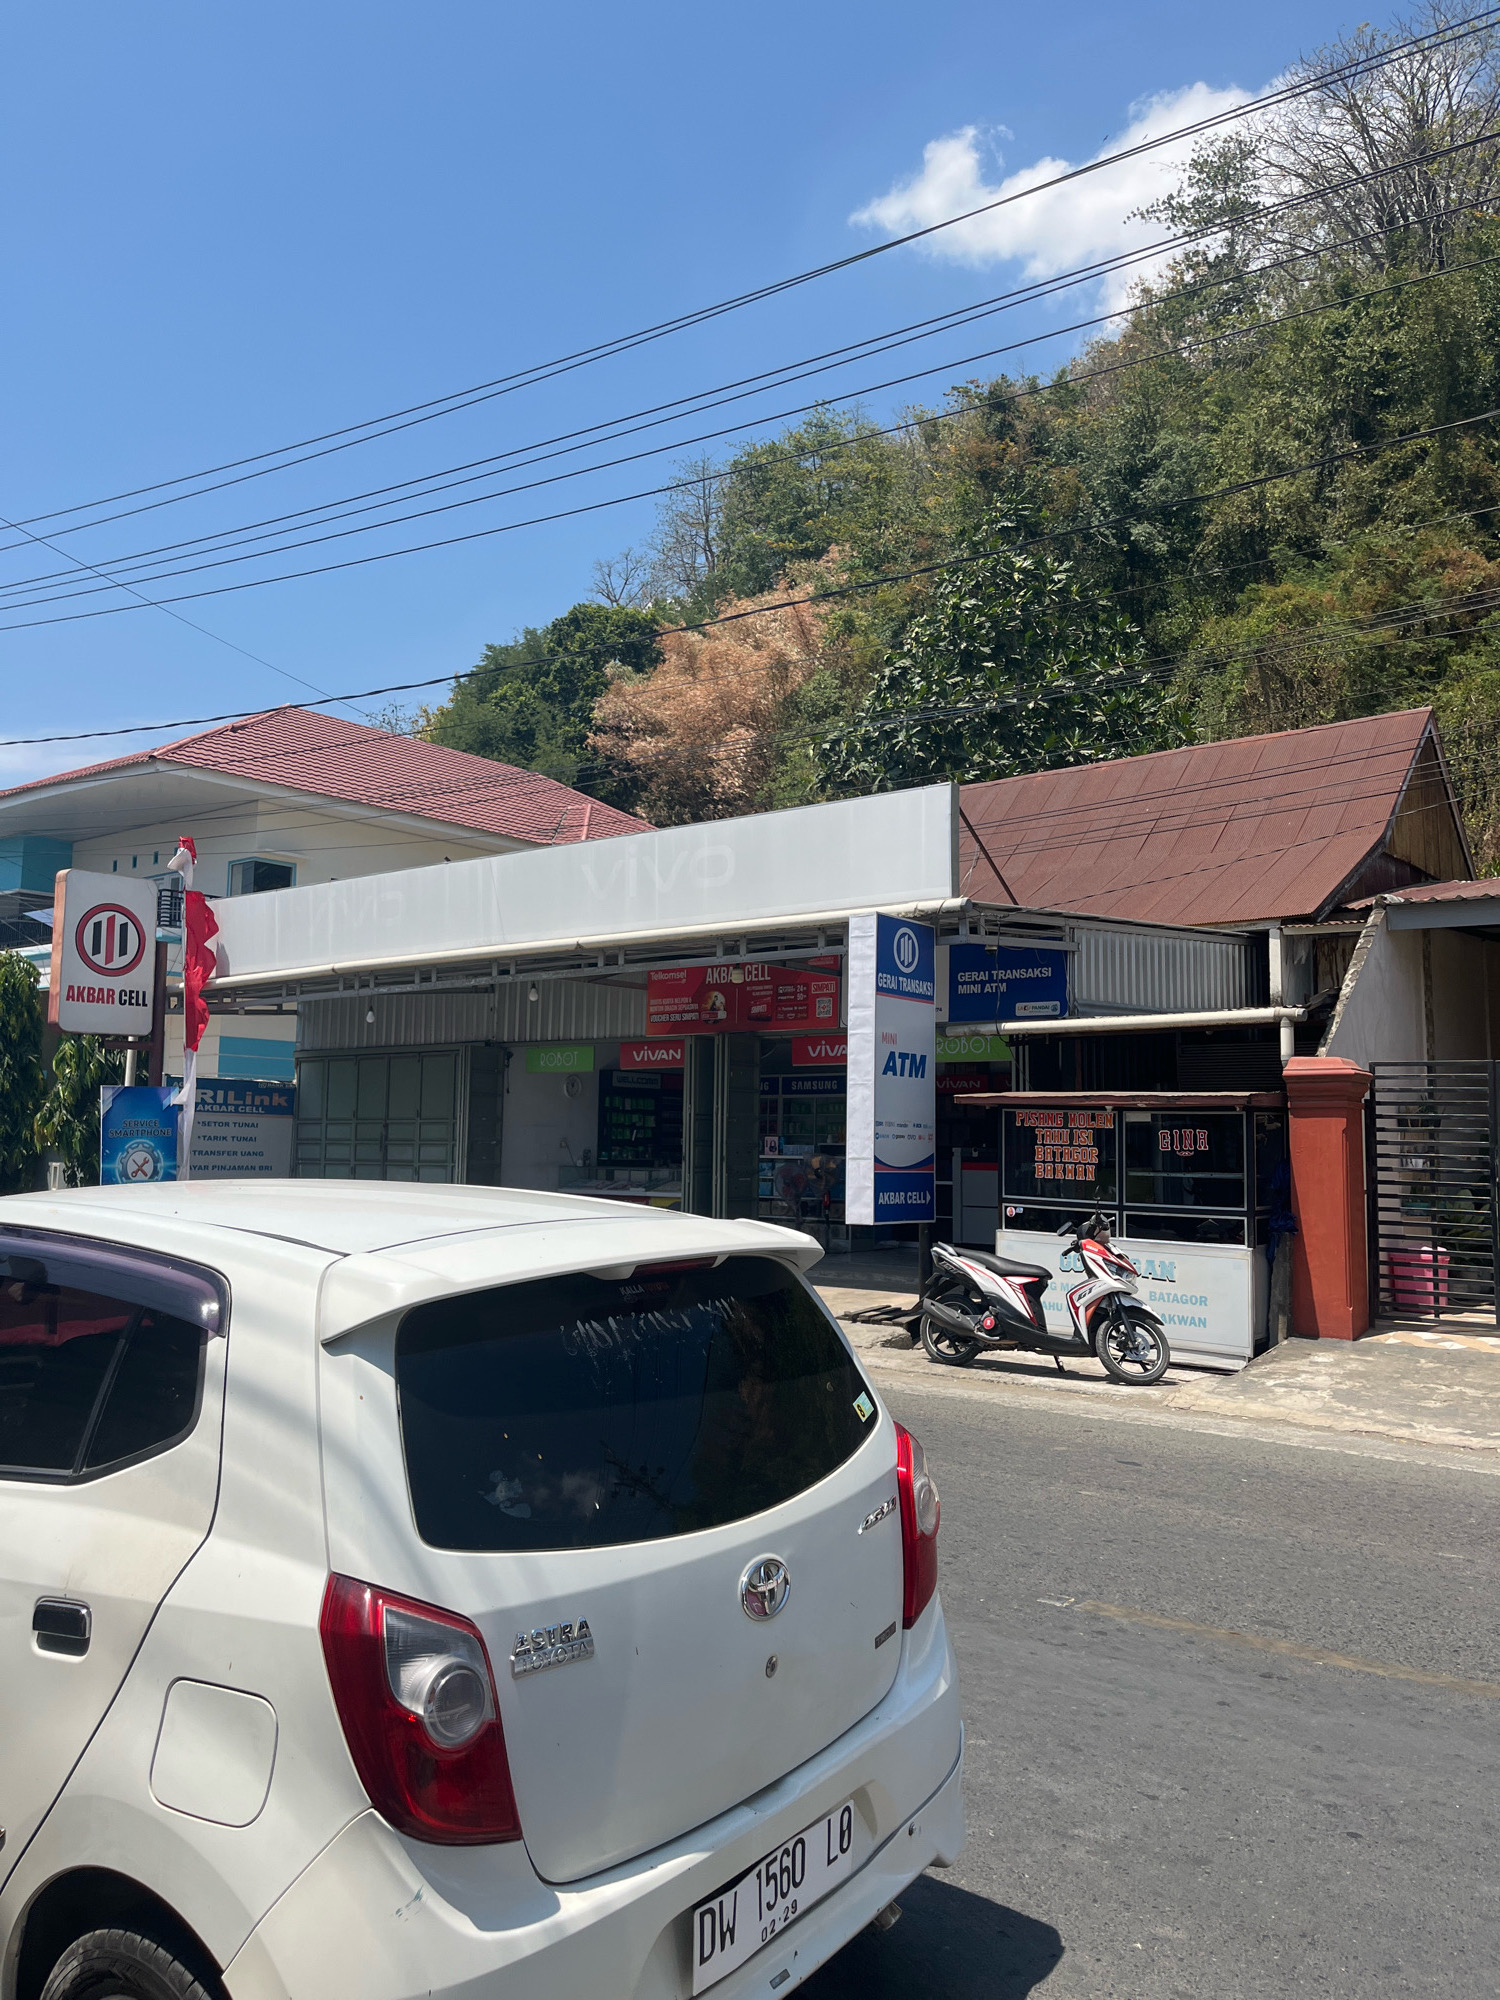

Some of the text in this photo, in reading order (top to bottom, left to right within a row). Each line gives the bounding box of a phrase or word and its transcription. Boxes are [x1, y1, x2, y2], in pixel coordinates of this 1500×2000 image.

[650, 969, 687, 981] Telkomsel
[705, 964, 771, 984] AKBA CELL
[957, 967, 1052, 982] GERAI TRANSAKSI
[812, 983, 835, 993] SIMPATI
[877, 972, 934, 996] GERAI TRANSAKSI
[957, 982, 1007, 994] MINI ATM
[65, 984, 148, 1007] AKBAR CELL
[881, 1031, 897, 1045] MINI
[935, 1036, 992, 1055] ROBOT
[540, 1051, 579, 1067] ROBOT
[882, 1050, 927, 1079] ATM
[791, 1080, 838, 1090] SAMSUNG
[195, 1088, 288, 1107] RILink
[196, 1104, 265, 1114] AKBAR CELL
[122, 1119, 160, 1128] SERVICE
[1015, 1111, 1114, 1129] PISANG MOLEN
[108, 1128, 172, 1138] SMARTPHONE
[231, 1135, 257, 1143] TUNAI
[1035, 1128, 1094, 1146] TAHU ISI
[1158, 1129, 1209, 1151] GINA
[1035, 1145, 1099, 1164] BATAGOR
[1035, 1162, 1096, 1181] BAKWAN
[878, 1191, 925, 1205] AKBAR CELL
[1149, 1290, 1209, 1307] BATAGOR
[1161, 1314, 1208, 1329] AKWAN
[511, 1615, 592, 1657] ASTRA
[516, 1641, 592, 1672] TOYOTA
[699, 1890, 738, 1967] DW
[756, 1836, 806, 1922] 1560
